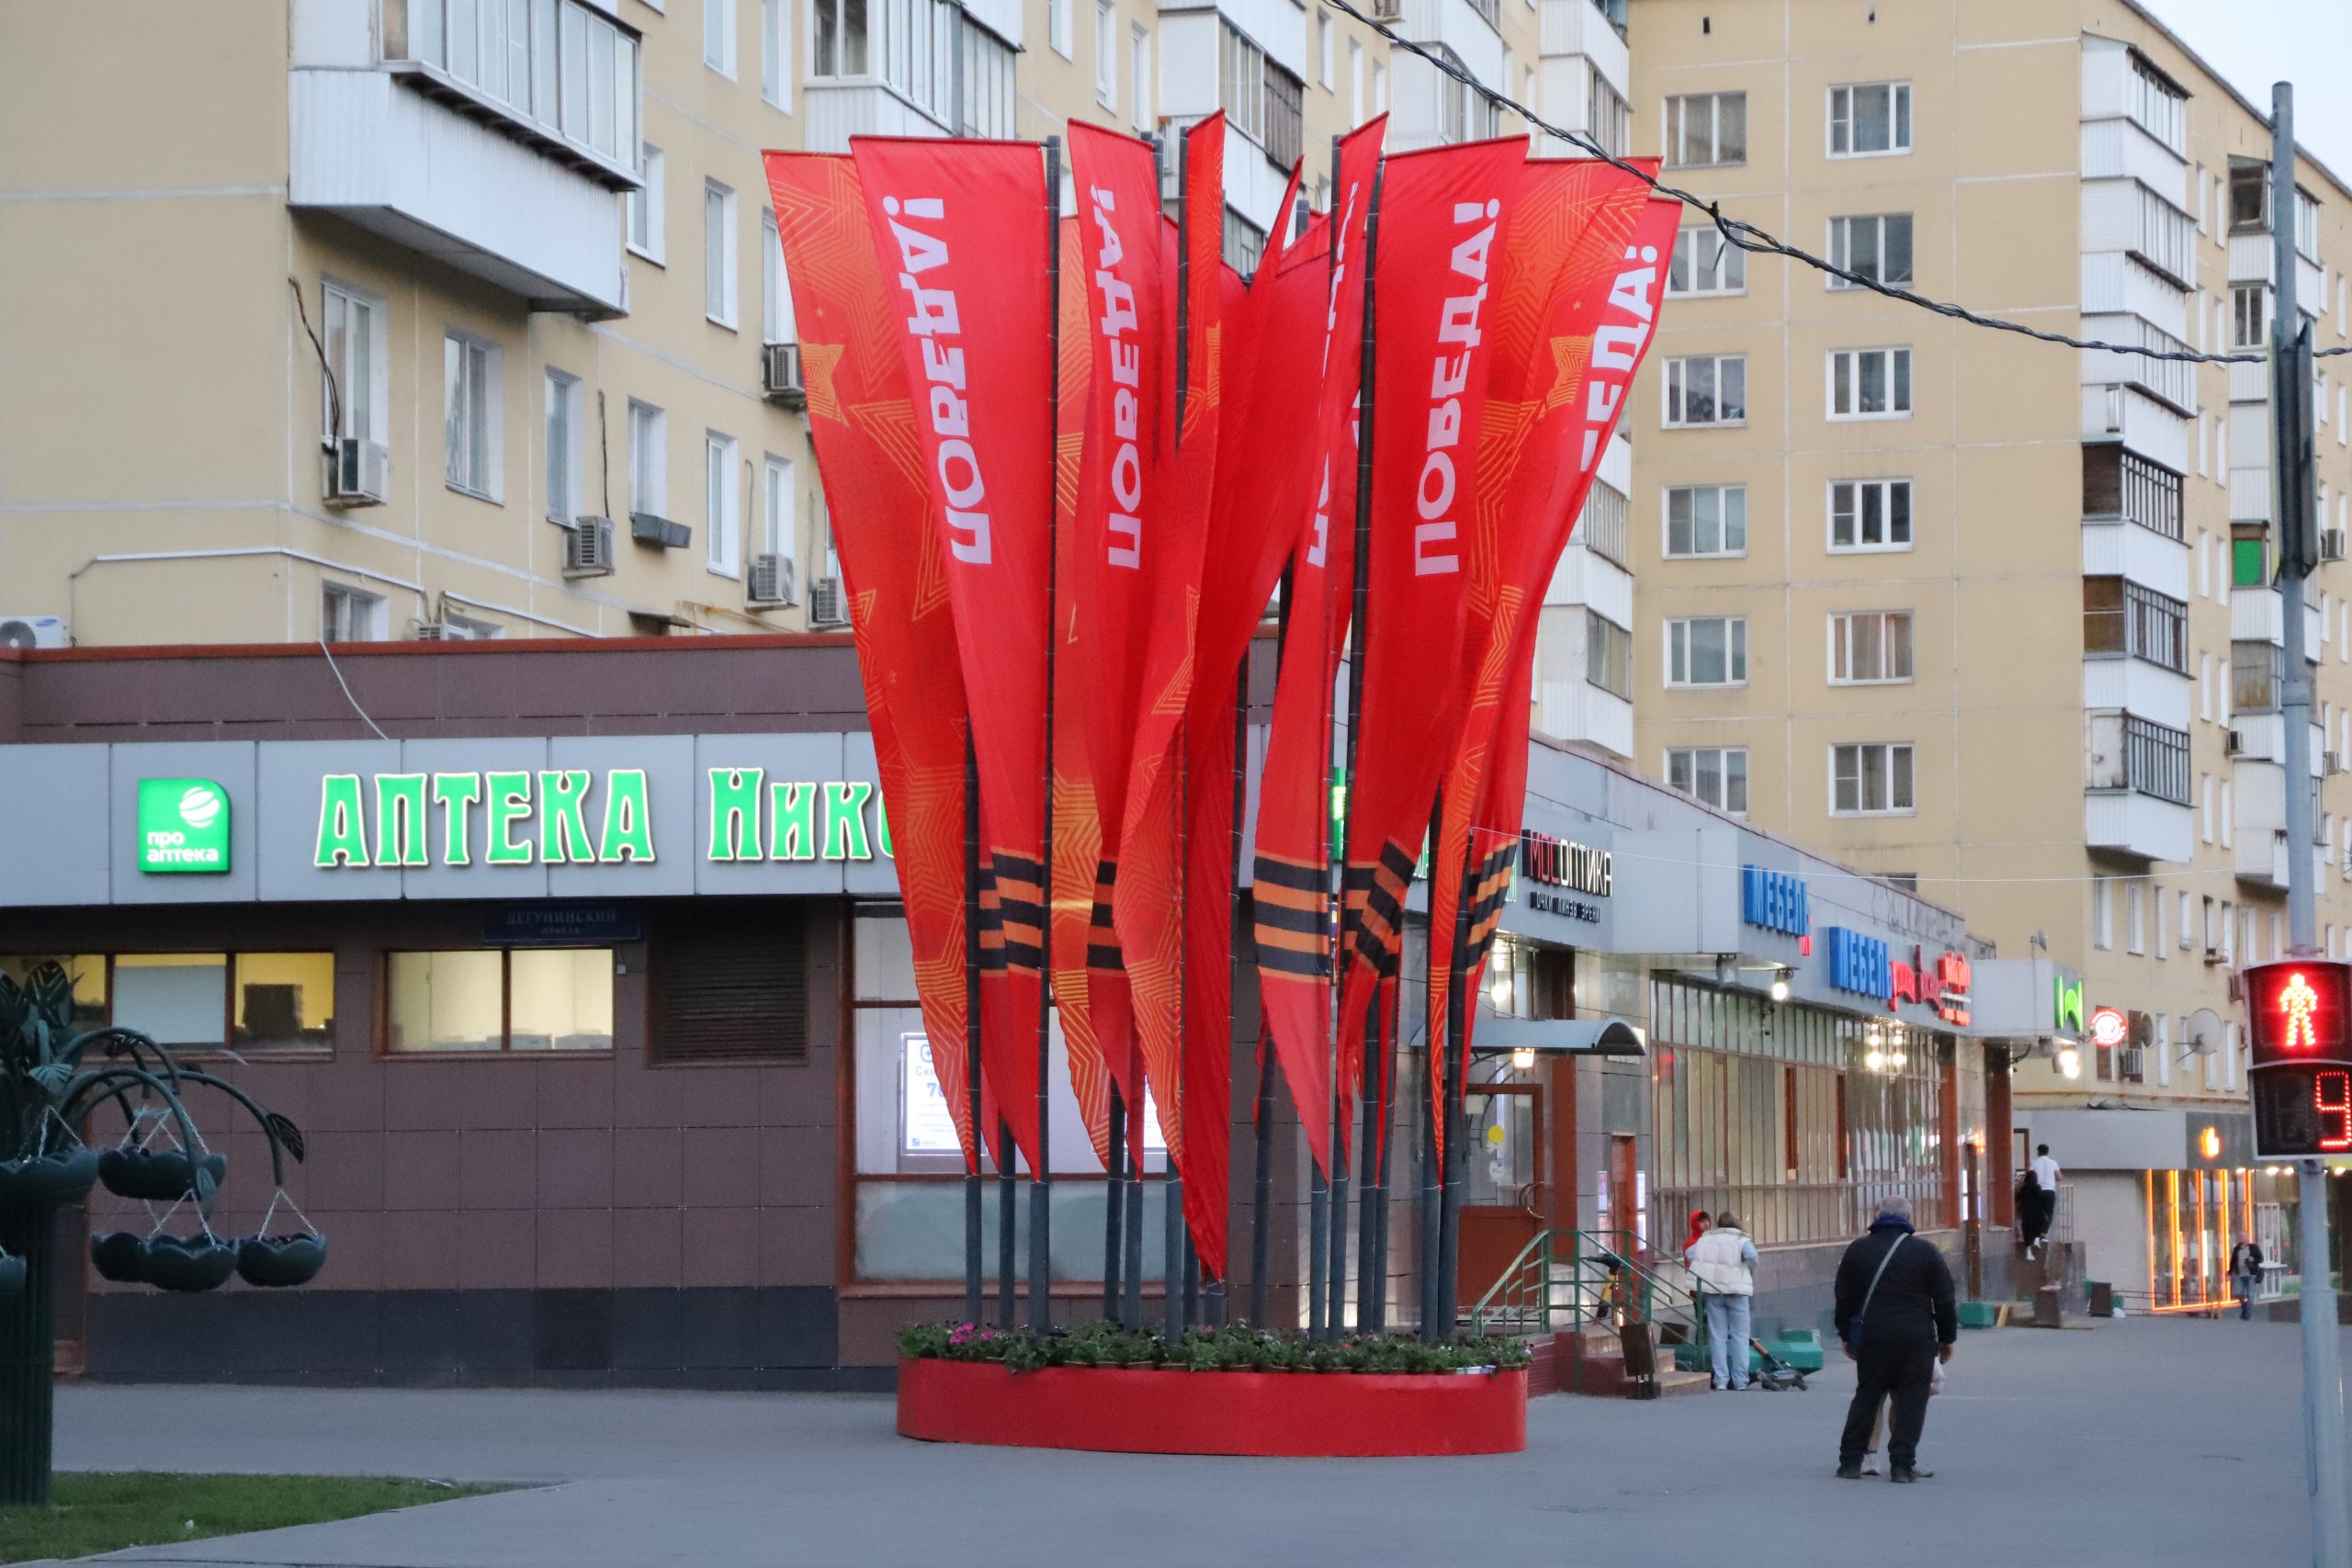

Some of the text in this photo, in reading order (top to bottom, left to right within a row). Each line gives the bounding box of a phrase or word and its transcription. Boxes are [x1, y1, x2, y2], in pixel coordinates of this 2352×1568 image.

[1415, 198, 1500, 577] ПОБЕДА!
[147, 831, 185, 848] про
[314, 767, 895, 866] АПТЕКА Ник
[147, 848, 220, 863] аптека
[1529, 829, 1612, 897] МОСОПТИКА
[506, 908, 617, 926] ДЕГУНИНСКИЙ
[1744, 863, 1810, 937] МЕБЕЛЬ
[1829, 926, 1893, 1000] МЕБЕЛЬ
[2316, 1071, 2352, 1146] 9
